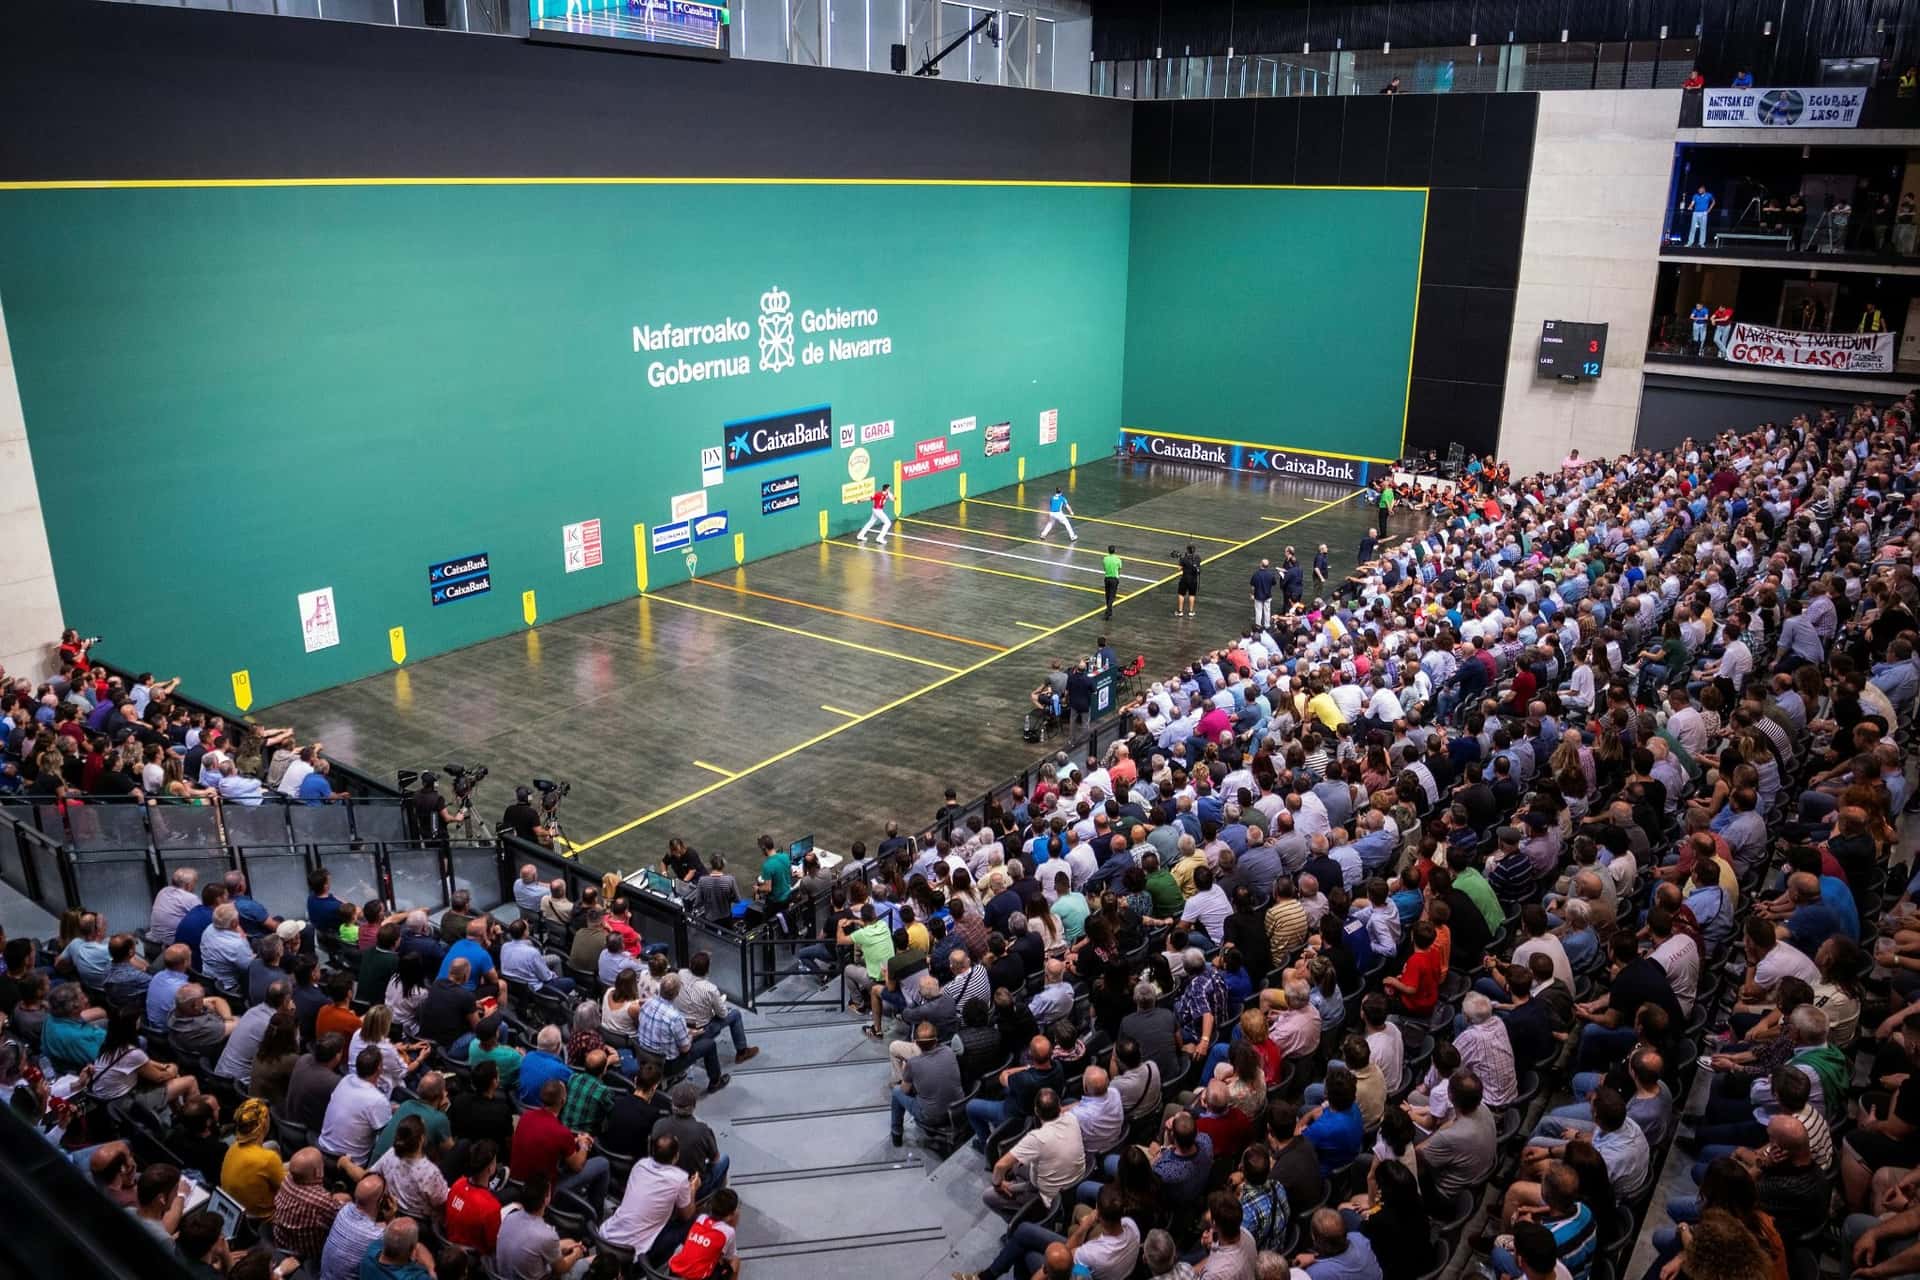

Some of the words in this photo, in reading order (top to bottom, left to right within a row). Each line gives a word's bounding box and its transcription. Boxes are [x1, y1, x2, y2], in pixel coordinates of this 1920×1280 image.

[1810, 109, 1840, 121] LASO
[801, 306, 879, 333] Gobierno
[632, 316, 751, 353] Nafarroako
[802, 342, 824, 366] de
[829, 336, 892, 362] Navarra
[1589, 340, 1599, 353] 3
[1732, 343, 1786, 364] GORA
[647, 355, 751, 388] Gobernua
[1583, 362, 1599, 375] 12
[752, 418, 830, 453] CaixaBank
[841, 429, 853, 441] DV
[864, 422, 890, 439] GARA
[704, 449, 720, 464] DN
[1150, 437, 1227, 464] CaixaBank
[1271, 452, 1355, 481] CaixaBank
[770, 477, 799, 493] CaixaBank
[771, 495, 799, 510] CaixaBank
[443, 557, 488, 577] CaixaBank
[446, 578, 490, 598] CaixaBank
[393, 630, 401, 639] 9
[234, 673, 247, 686] 10
[689, 1232, 711, 1248] LASO
